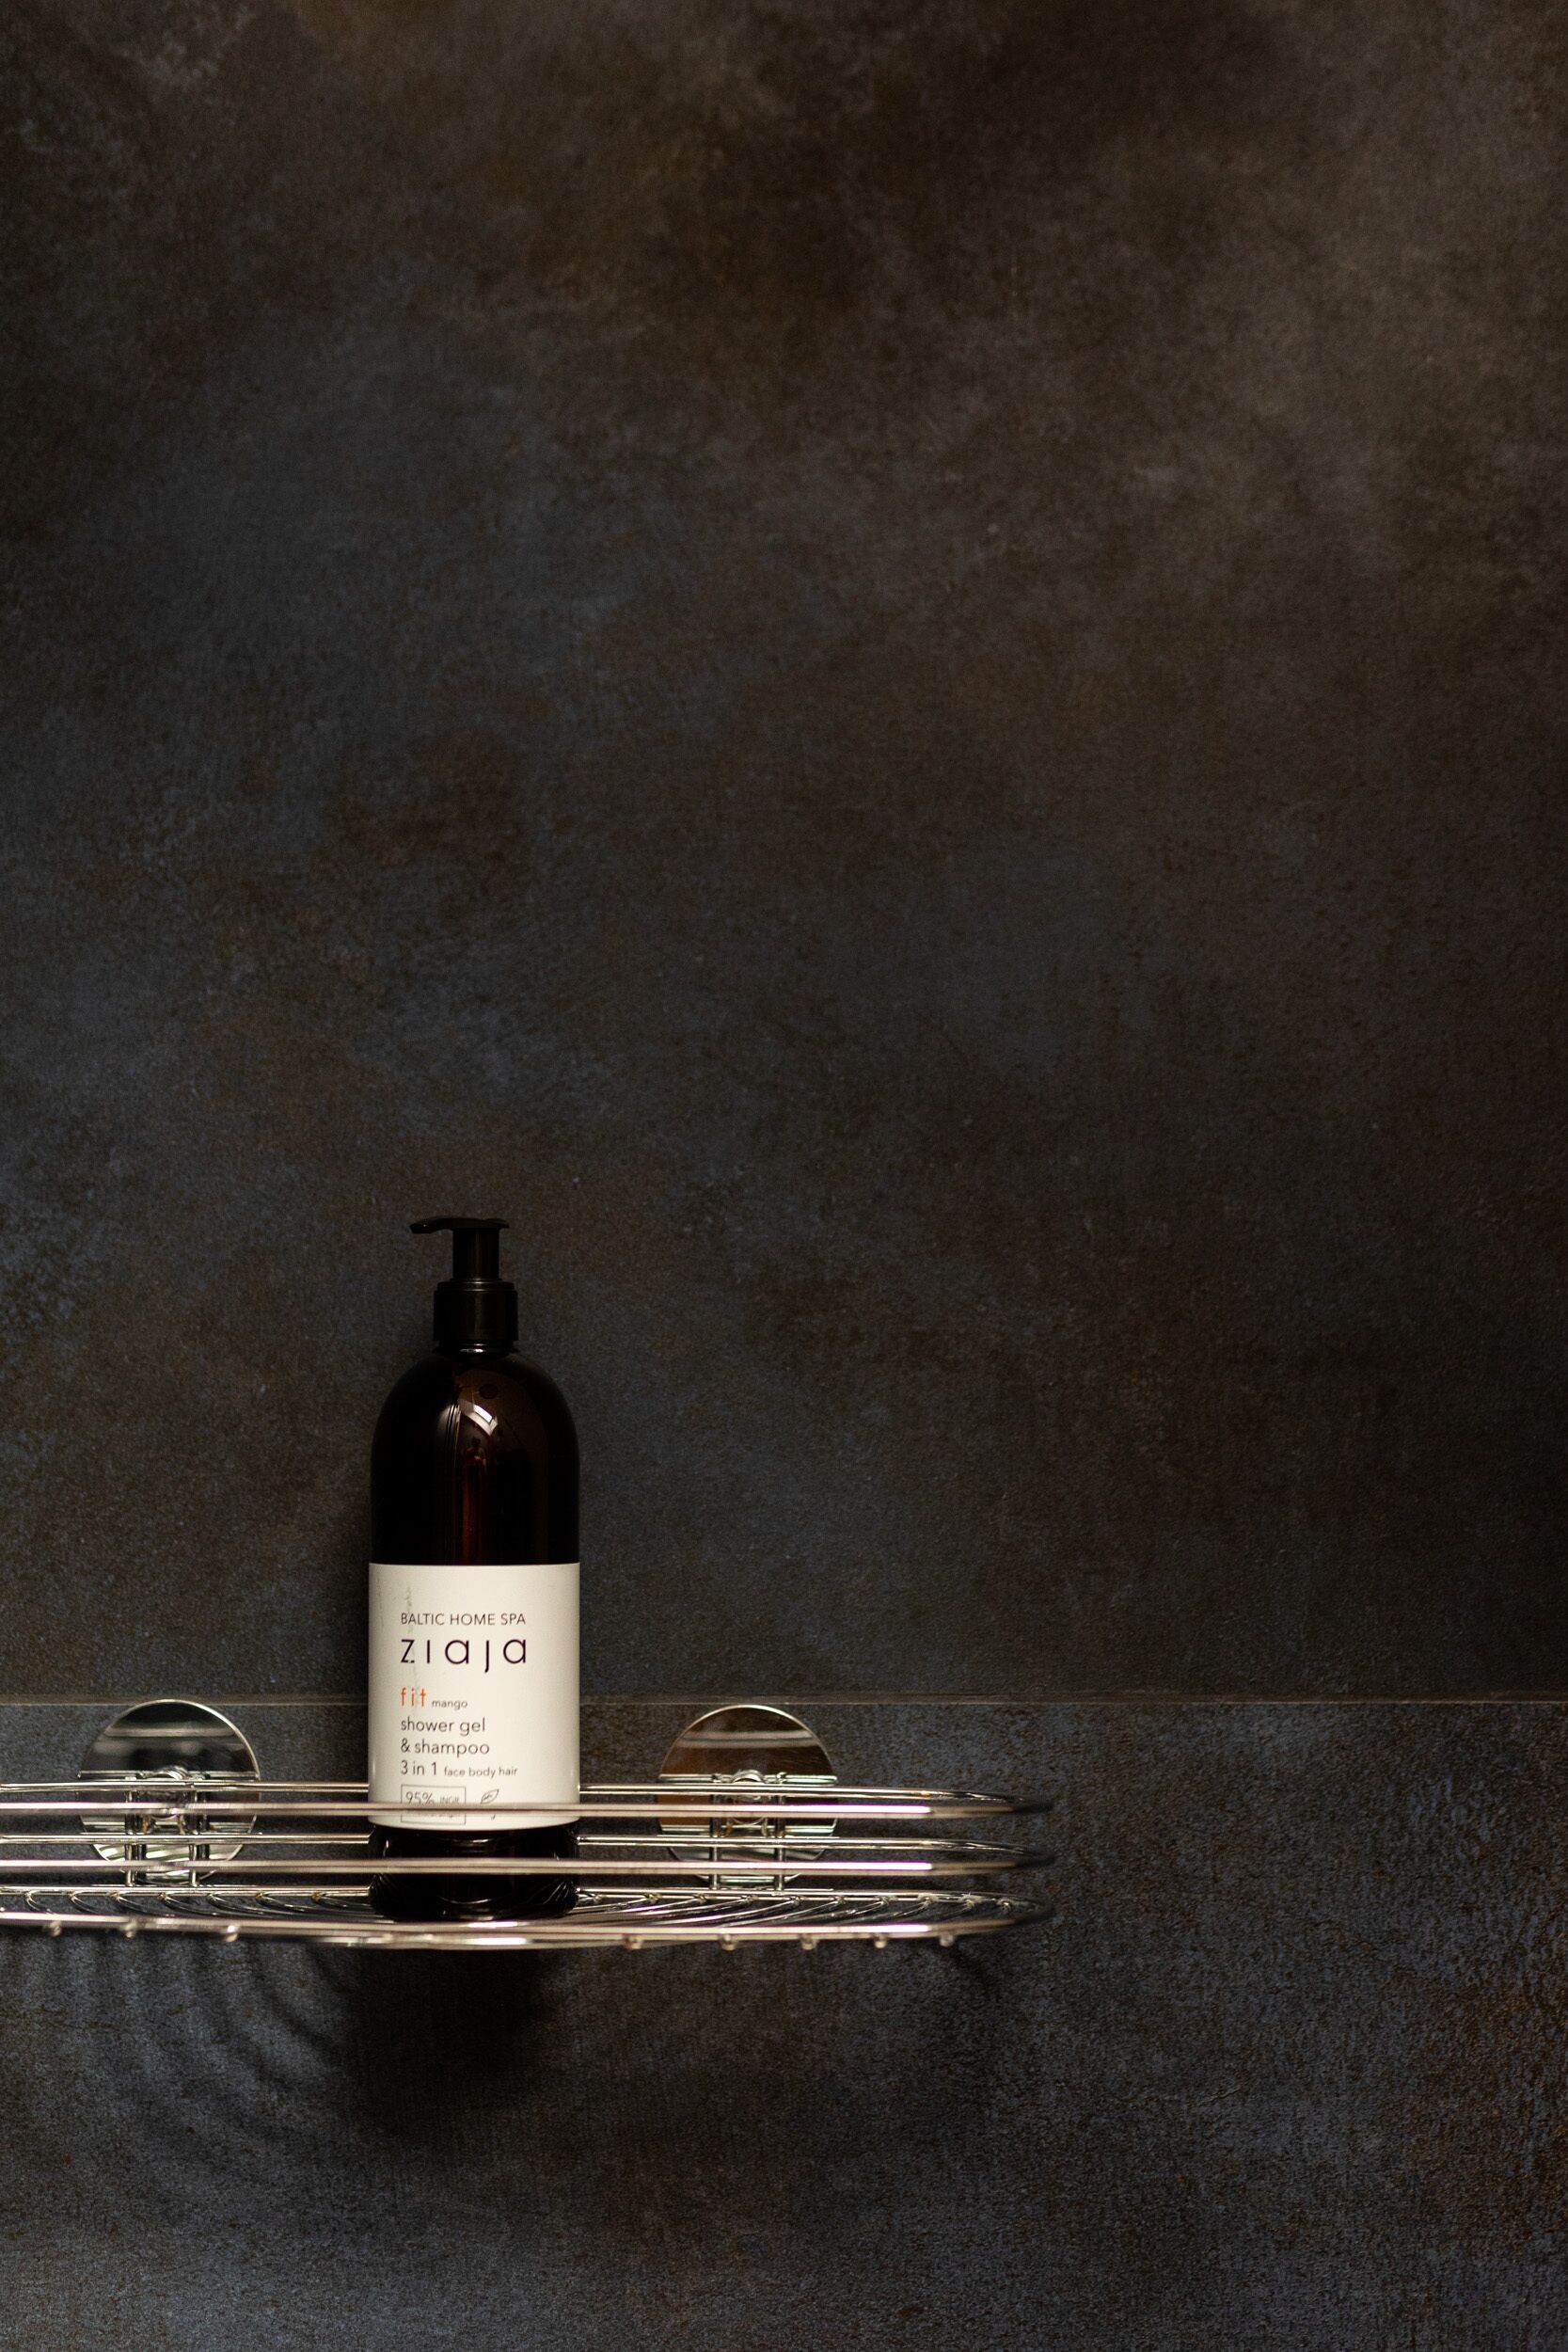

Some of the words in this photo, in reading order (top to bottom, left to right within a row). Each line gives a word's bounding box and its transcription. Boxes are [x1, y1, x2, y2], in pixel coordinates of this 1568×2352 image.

[401, 1613, 444, 1626] BALTIC
[450, 1613, 495, 1626] HOME
[500, 1613, 527, 1626] SPA
[400, 1639, 527, 1674] ziaja
[401, 1686, 426, 1708] fit
[432, 1699, 468, 1711] mango
[401, 1715, 454, 1732] shower
[459, 1717, 485, 1737] gel
[401, 1738, 410, 1754] &
[414, 1739, 490, 1758] shampoo
[401, 1759, 408, 1775] 3
[412, 1760, 425, 1775] in
[431, 1762, 437, 1776] 1
[444, 1766, 466, 1777] face
[468, 1766, 497, 1779] body
[499, 1766, 518, 1776] hair
